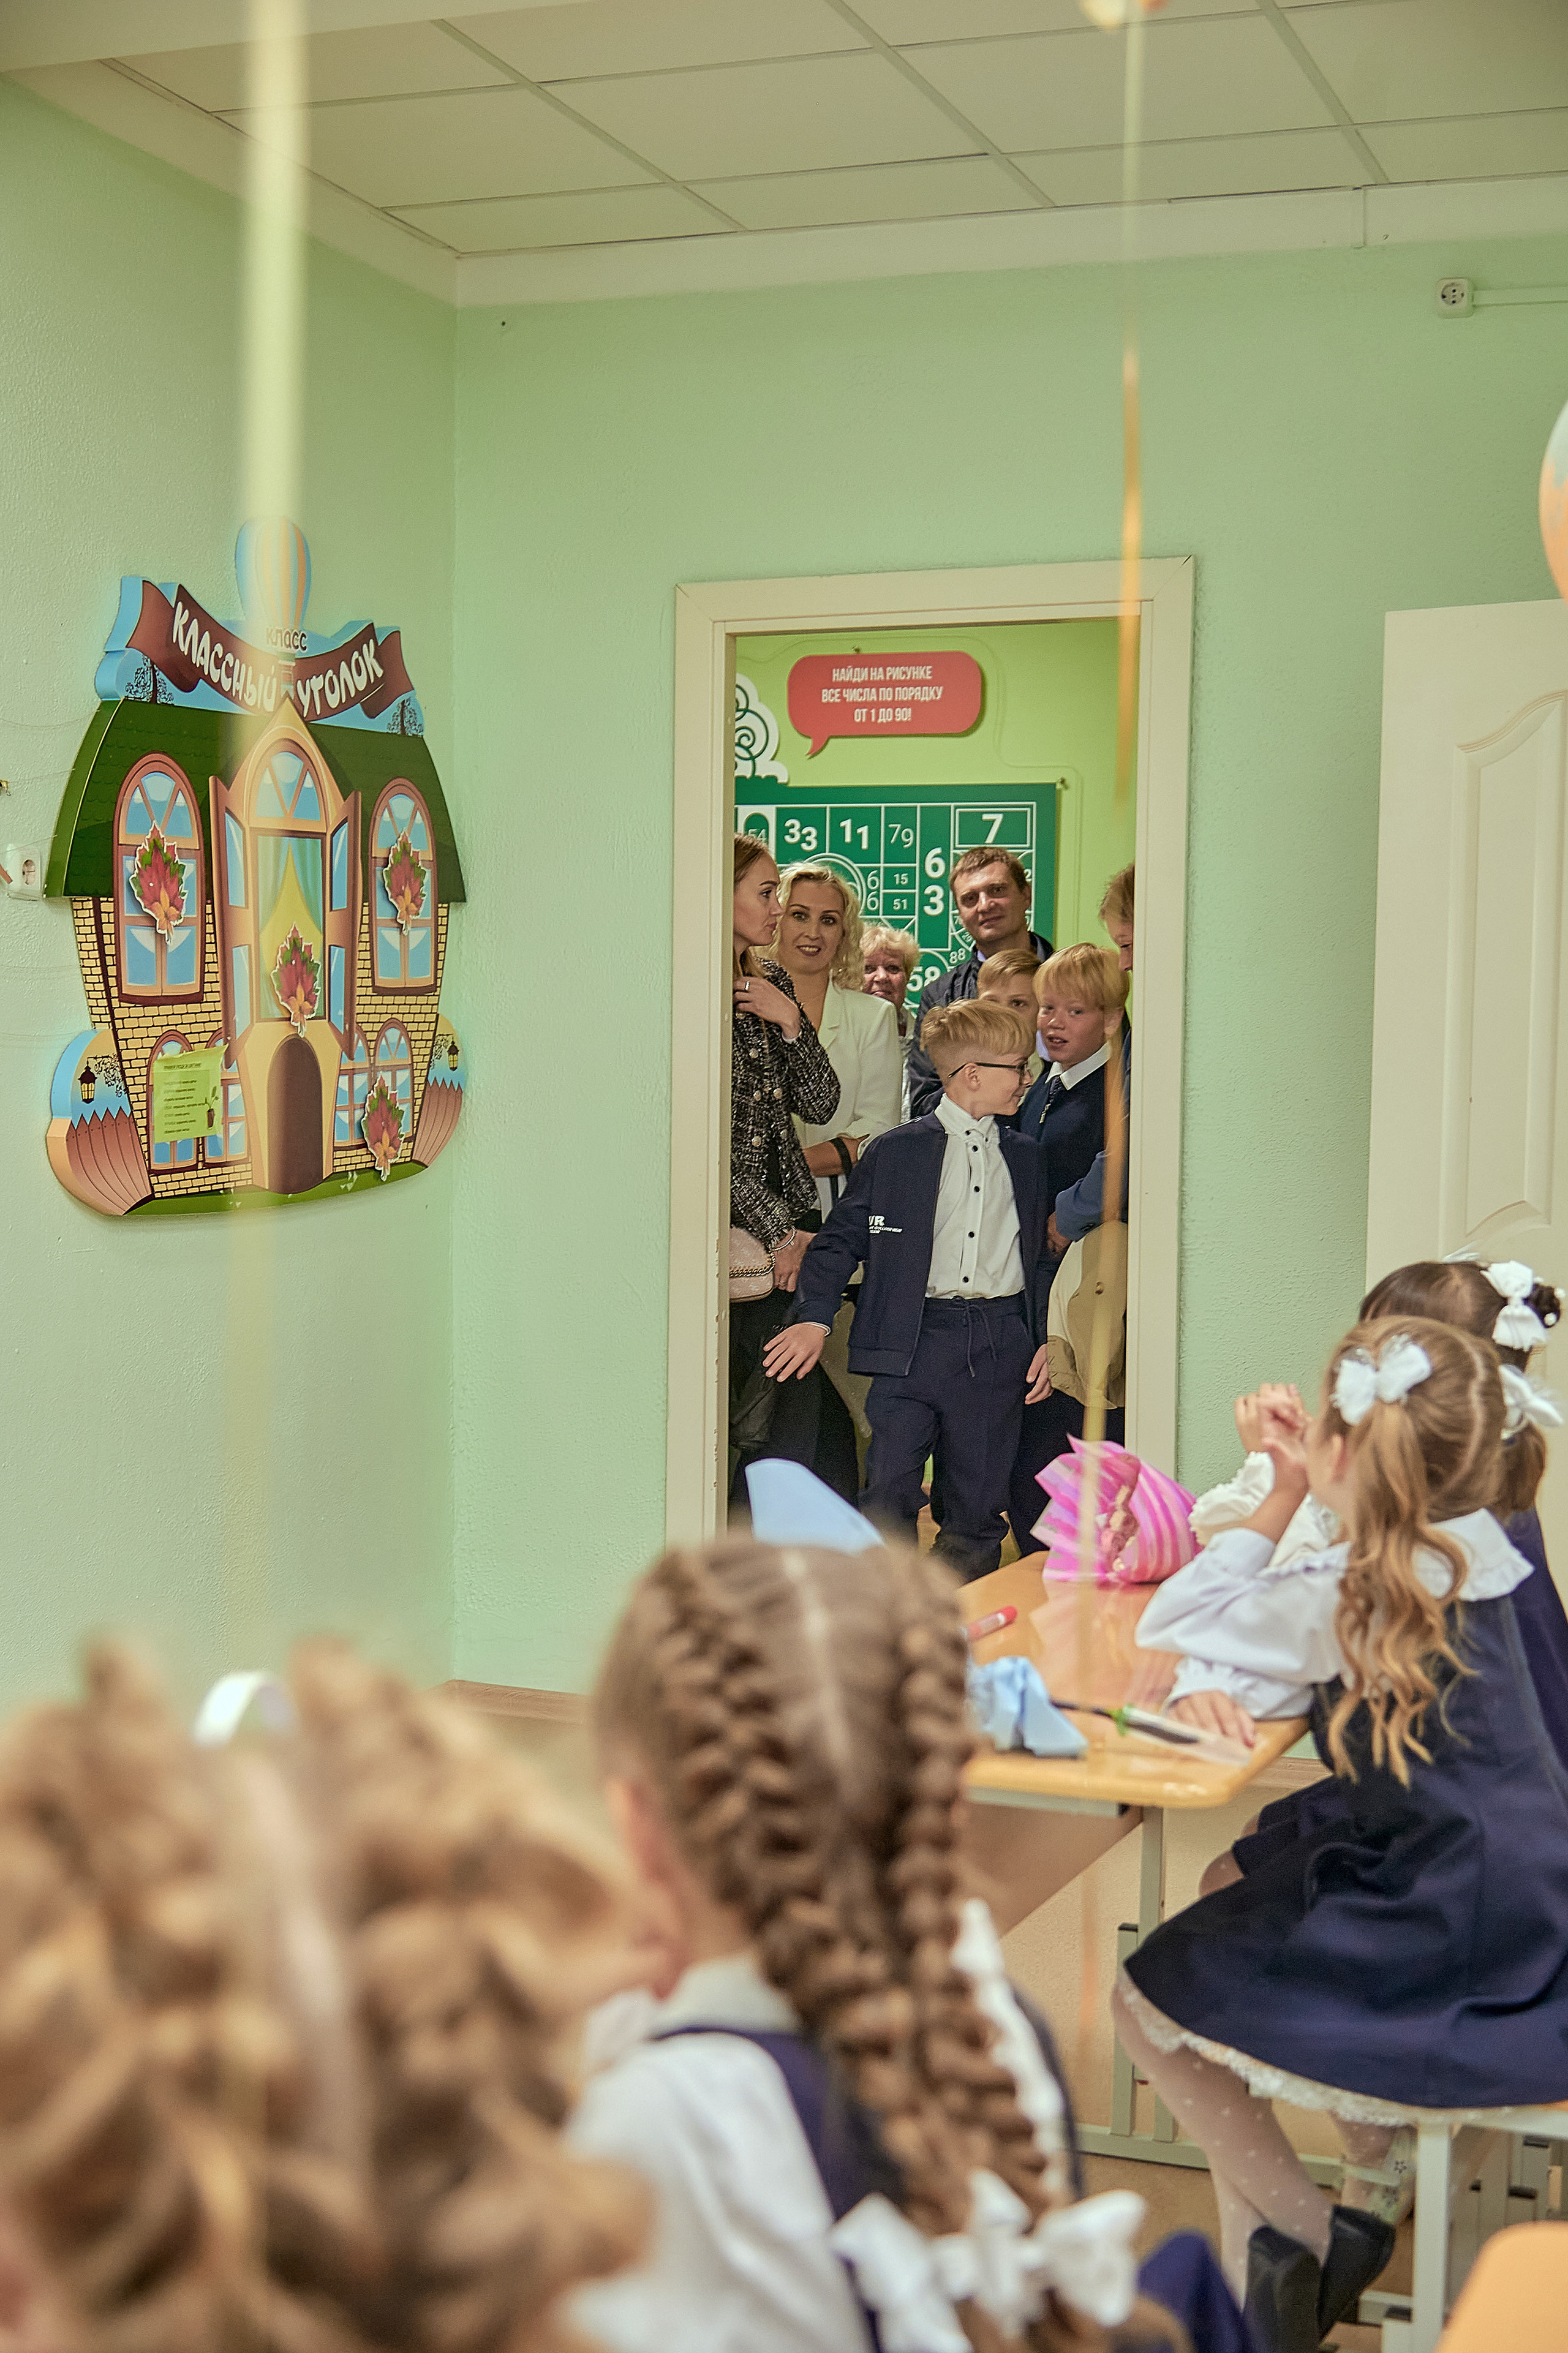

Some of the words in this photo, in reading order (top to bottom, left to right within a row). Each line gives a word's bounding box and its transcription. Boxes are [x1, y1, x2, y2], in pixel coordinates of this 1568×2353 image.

[172, 601, 277, 712] КЛАССНЫЙ
[296, 638, 384, 718] УГОЛОК
[832, 666, 869, 683] НАЙДИ
[870, 667, 884, 680] НА
[886, 666, 933, 680] РИСУНКЕ
[821, 688, 841, 702] ВСЕ
[843, 688, 877, 702] ЧИСЛА
[878, 687, 893, 701] ПО
[895, 686, 943, 702] ПОРЯДКУ
[854, 709, 867, 722] ОТ
[870, 708, 875, 722] 1
[877, 708, 894, 723] ДО
[895, 707, 911, 721] 90!
[784, 818, 818, 851] 33
[839, 818, 869, 850] 11
[888, 824, 914, 849] 79
[981, 813, 1004, 844] 7
[893, 873, 909, 885] 15
[892, 898, 908, 910] 51
[949, 947, 966, 964] 88
